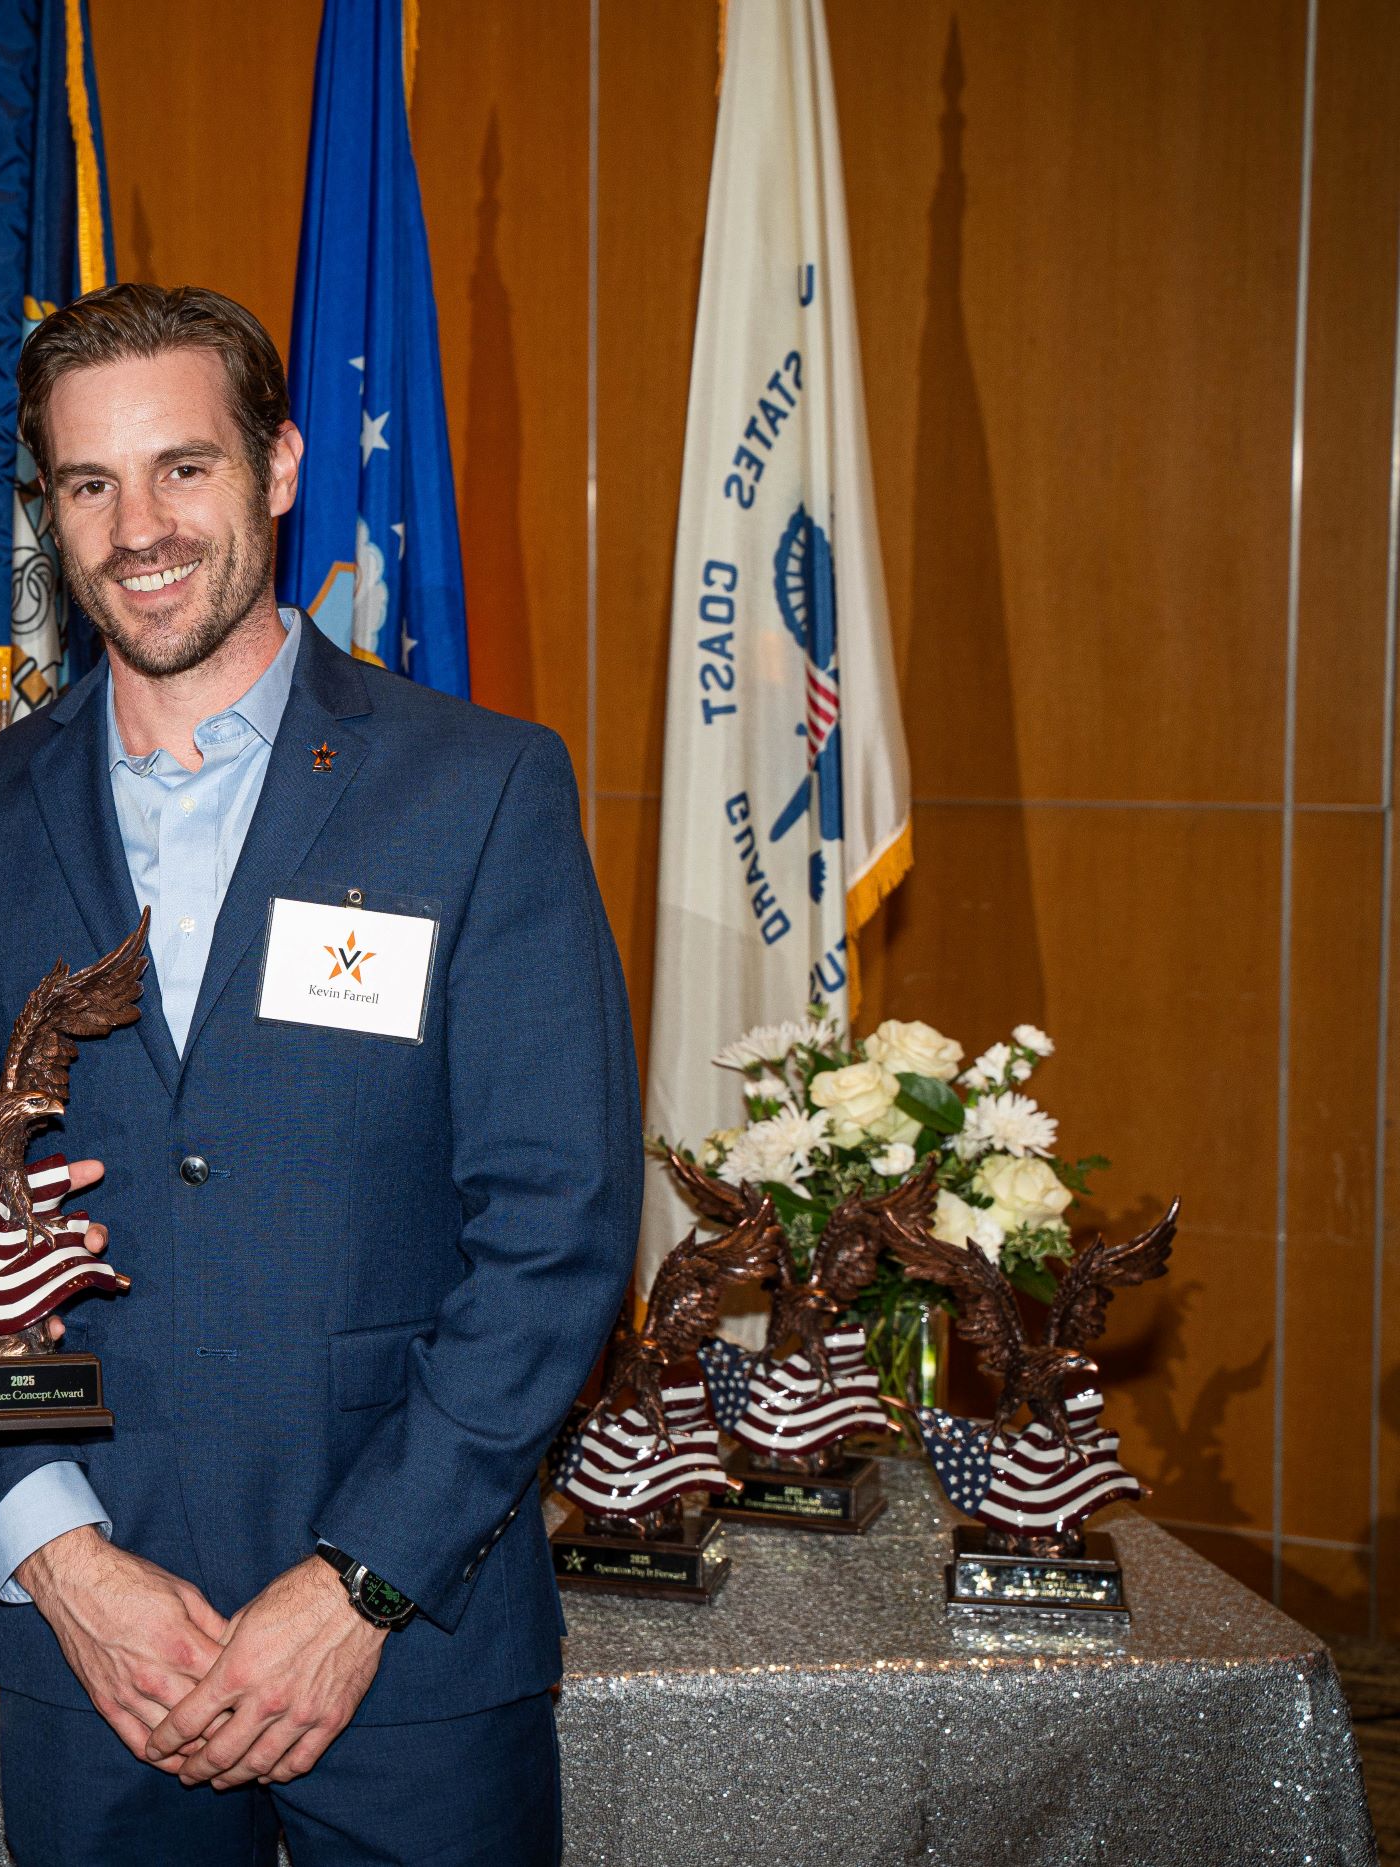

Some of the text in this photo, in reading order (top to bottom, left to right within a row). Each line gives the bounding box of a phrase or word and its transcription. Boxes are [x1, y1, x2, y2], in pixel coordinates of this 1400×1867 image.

[307, 984, 379, 1005] Kevin Farrell
[11, 1375, 35, 1387] 2025
[13, 1389, 53, 1402] Concept
[55, 1388, 84, 1399] Award
[630, 1554, 650, 1564] 2025
[632, 1566, 645, 1578] Pay
